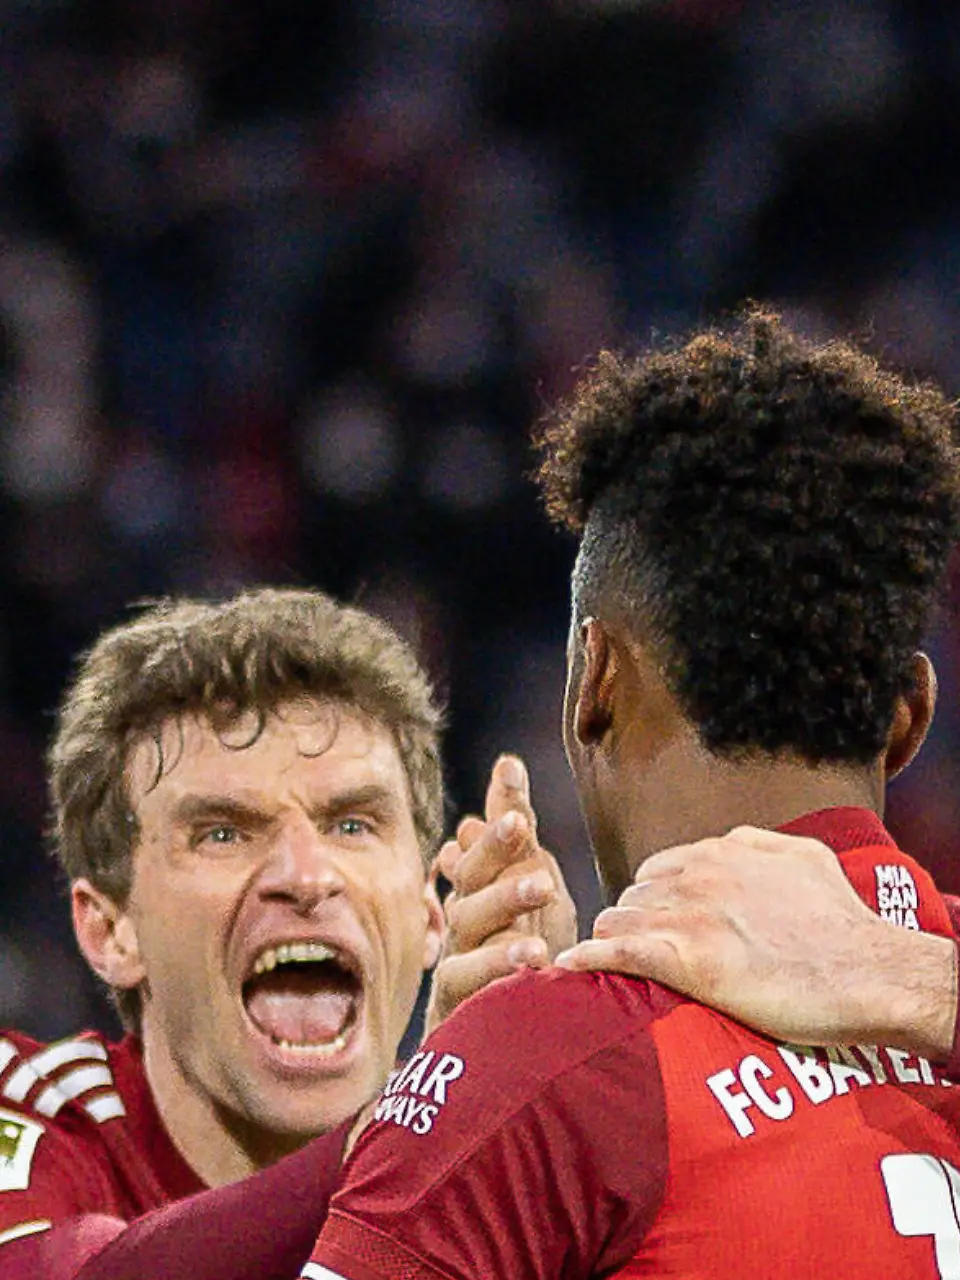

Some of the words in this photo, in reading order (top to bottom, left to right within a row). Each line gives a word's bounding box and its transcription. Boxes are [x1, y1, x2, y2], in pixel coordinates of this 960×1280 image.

[874, 864, 917, 893] MIA
[878, 886, 918, 910] SAN
[383, 1050, 464, 1105] TAR
[706, 1054, 795, 1139] FC
[374, 1095, 440, 1135] WAYS
